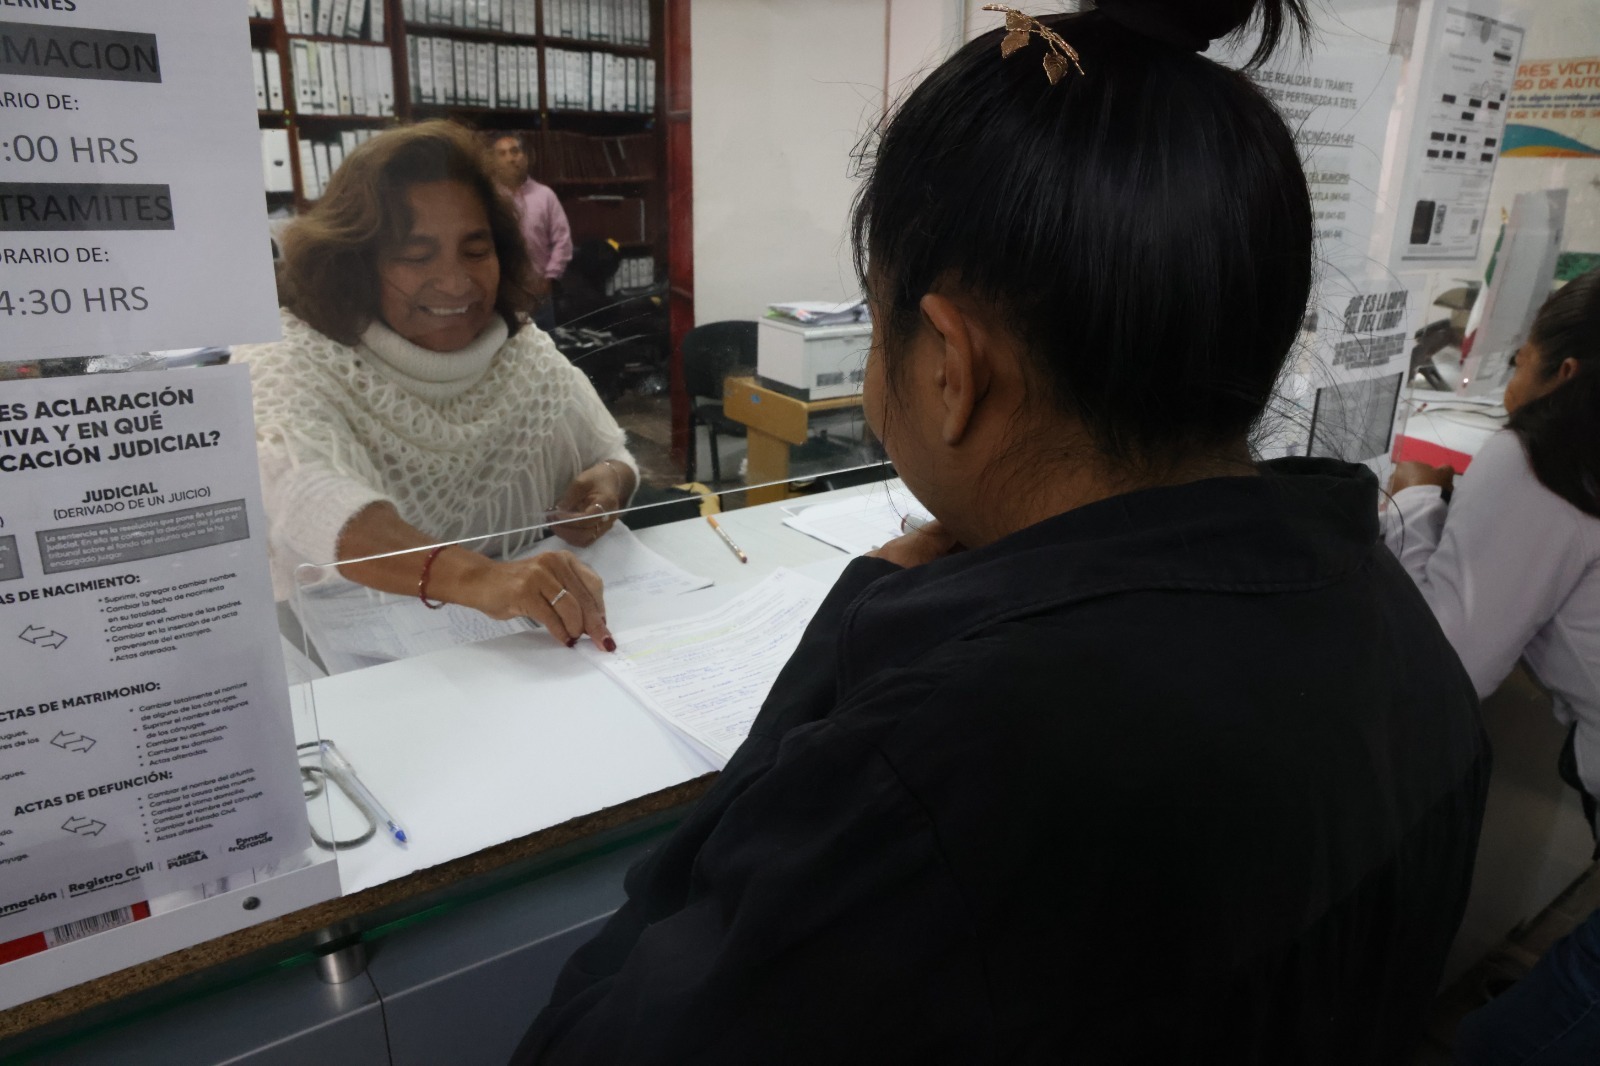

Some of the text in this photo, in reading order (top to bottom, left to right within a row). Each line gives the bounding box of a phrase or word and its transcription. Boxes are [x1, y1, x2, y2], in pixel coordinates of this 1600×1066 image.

[1, 34, 159, 73] MACION
[46, 94, 80, 111] DE:
[2, 134, 139, 165] :00 HRS
[0, 194, 173, 222] TRAMITES
[76, 247, 110, 263] DE:
[0, 286, 149, 316] 4:30 HRS
[0, 387, 195, 421] ES ACLARACIÓN
[0, 410, 164, 447] IVA Y EN QUÉ
[0, 430, 221, 473] CACIÓN JUDICIAL?
[53, 486, 212, 521] (DERIVADO DE UN JUICIO)
[82, 482, 159, 504] JUDICIAL
[18, 589, 40, 602] DE
[42, 574, 141, 599] NACIMIENTO:
[38, 701, 60, 714] DE
[61, 681, 161, 710] MATRIMONIO:
[14, 770, 174, 817] ACTAS DE DEFUNCIÓN:
[69, 872, 123, 894] Registro
[125, 861, 154, 877] Civil
